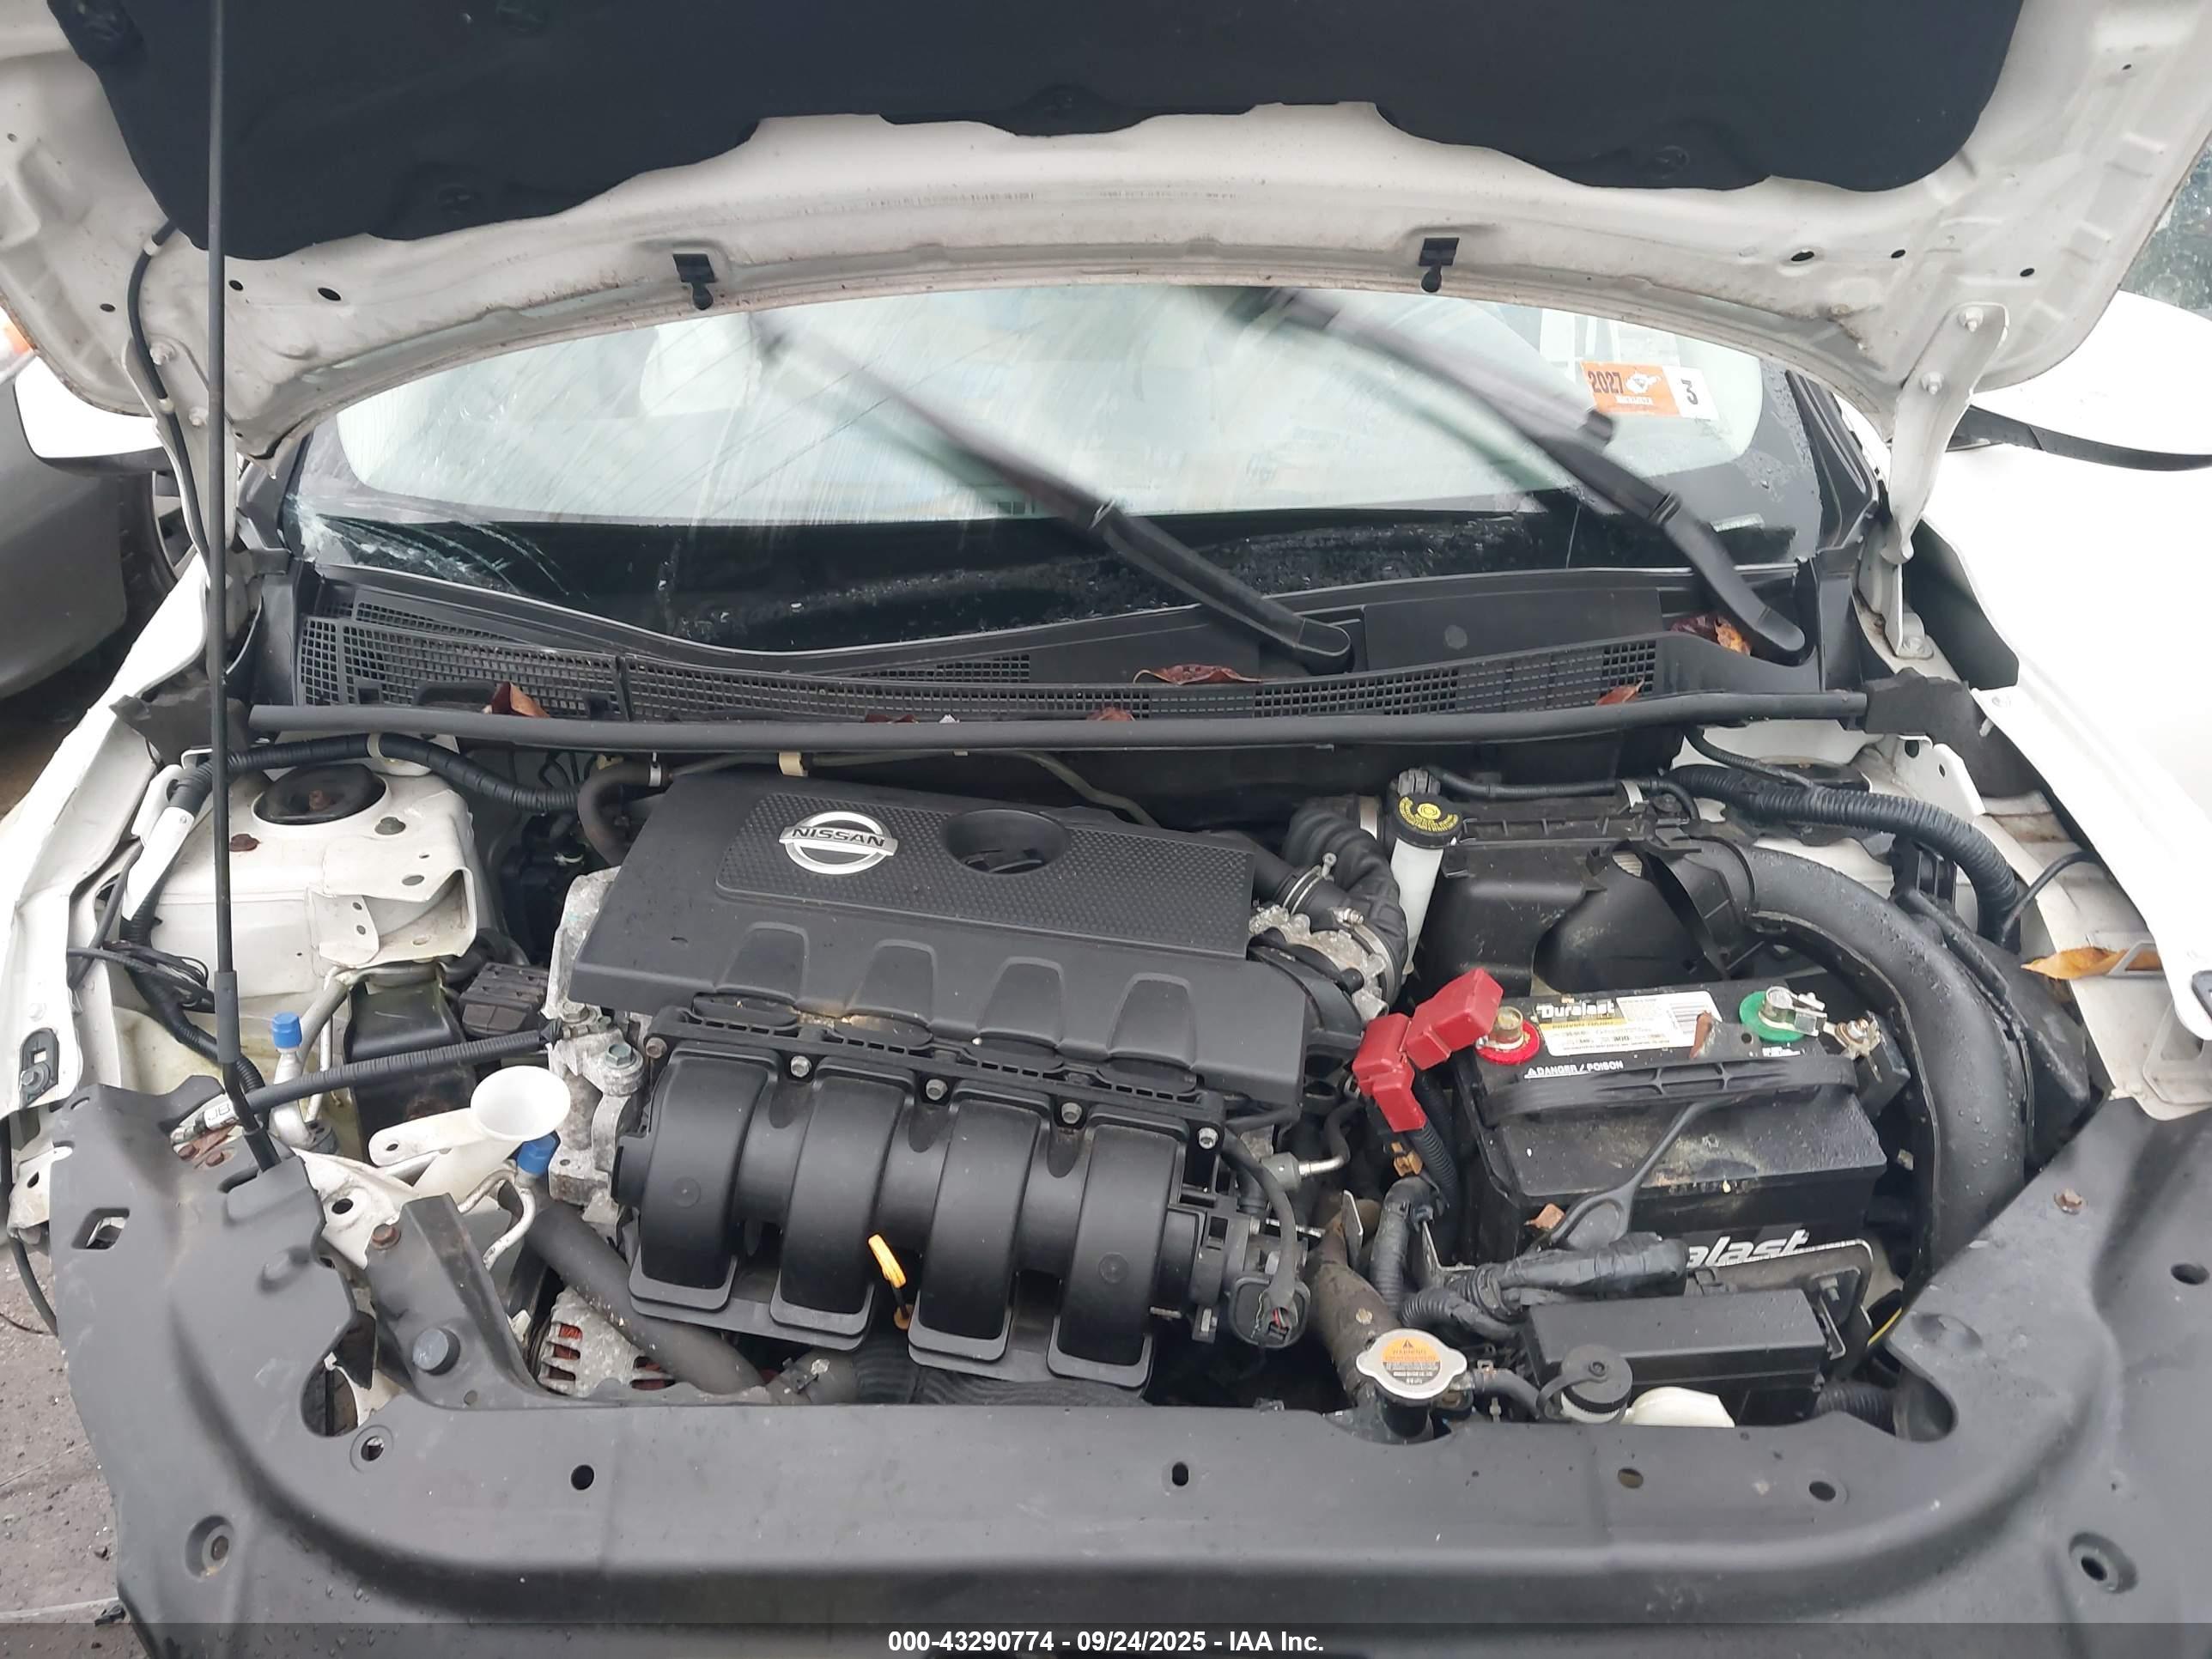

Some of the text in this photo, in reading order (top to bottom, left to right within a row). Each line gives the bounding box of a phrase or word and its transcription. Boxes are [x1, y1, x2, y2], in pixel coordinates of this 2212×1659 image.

[1588, 370, 1625, 394] 2027
[1680, 378, 1698, 405] 3
[792, 829, 885, 847] NISSAN
[1535, 1000, 1616, 1018] Duralast
[1536, 1064, 1578, 1076] DANGER
[1586, 1060, 1625, 1073] POISON
[1686, 1228, 1810, 1268] alast
